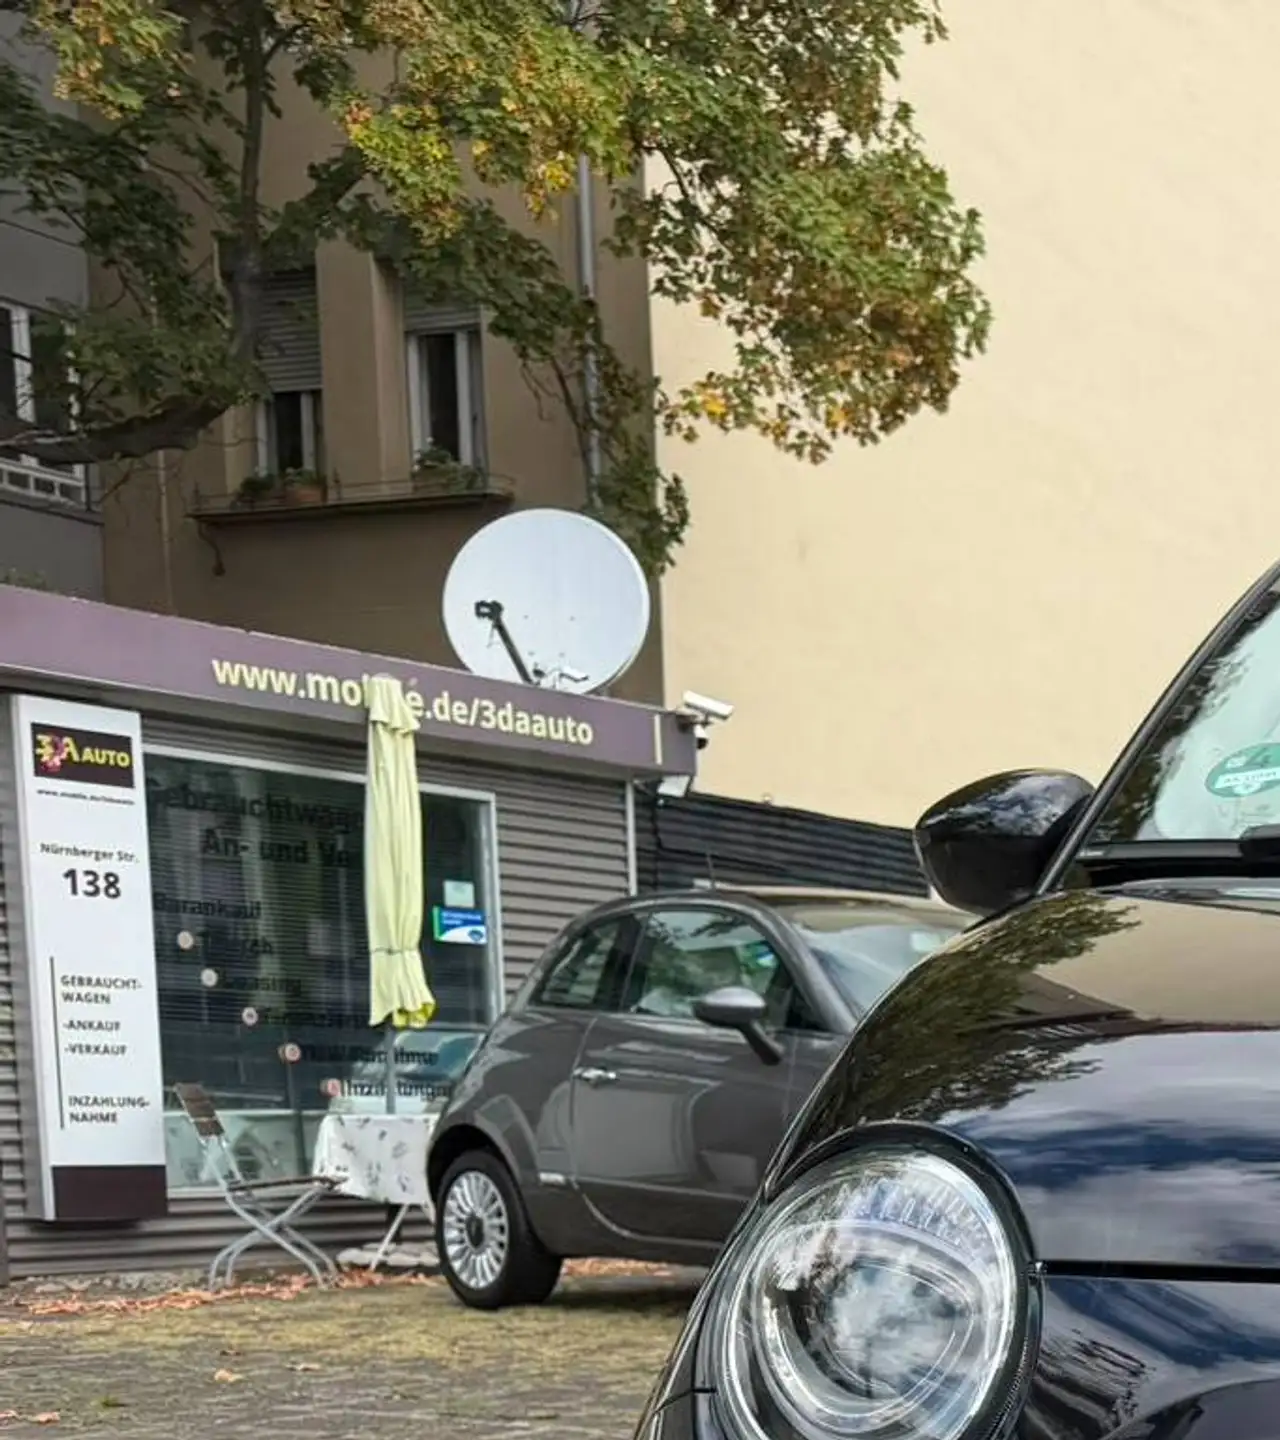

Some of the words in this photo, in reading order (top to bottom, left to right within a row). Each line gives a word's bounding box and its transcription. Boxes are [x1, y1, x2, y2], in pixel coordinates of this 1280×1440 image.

[211, 658, 594, 745] www.moe.de/3daauto
[81, 747, 130, 767] AUTO
[40, 842, 114, 862] Nürnberger
[117, 850, 139, 863] Str.
[63, 868, 121, 899] 138
[61, 975, 142, 990] GEBRAUCHT-
[62, 992, 111, 1005] WAGEN
[63, 1019, 121, 1032] -ANKAUF
[65, 1043, 127, 1056] -VERKAUF
[68, 1095, 150, 1109] INZAHLUNG-
[69, 1111, 117, 1124] NAHME
